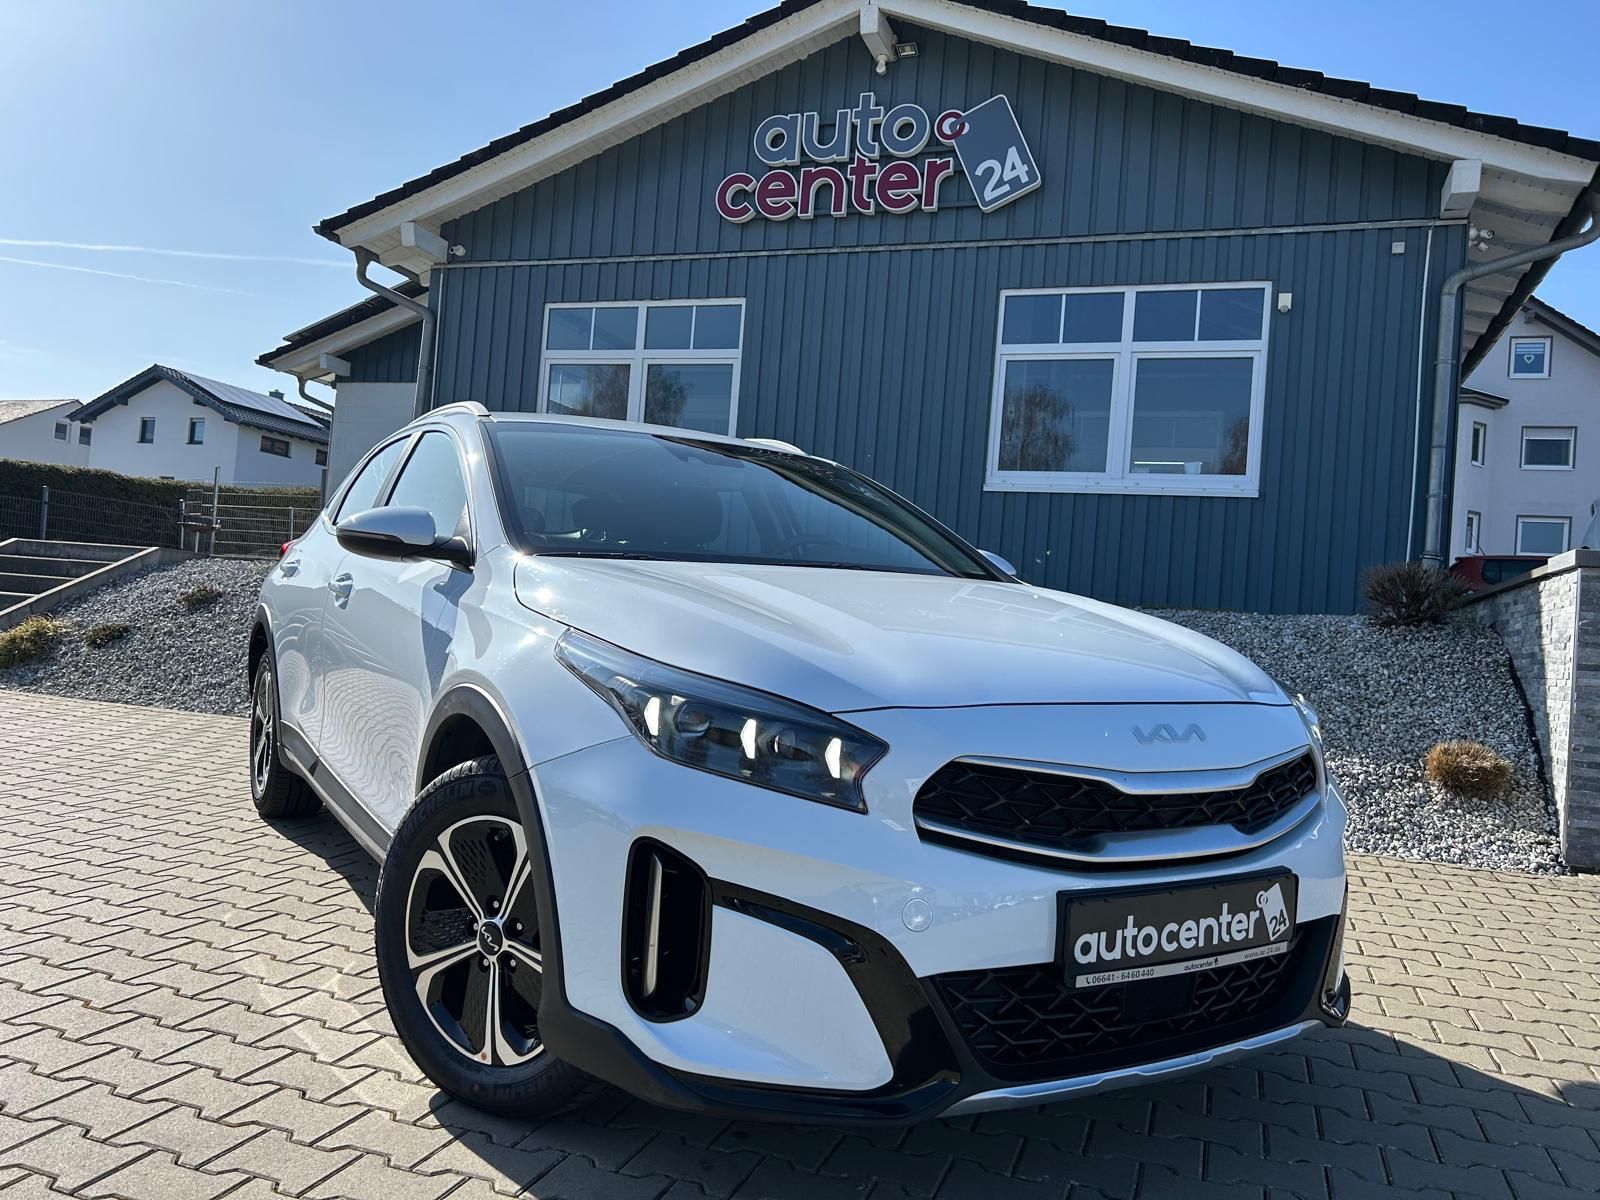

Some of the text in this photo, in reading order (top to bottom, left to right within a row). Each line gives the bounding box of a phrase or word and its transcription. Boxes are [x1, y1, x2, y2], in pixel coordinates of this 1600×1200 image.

[753, 92, 931, 167] auto
[715, 150, 954, 224] center
[974, 145, 1029, 202] 24
[1073, 902, 1260, 965] autocenter
[1268, 908, 1287, 936] 24
[1091, 973, 1116, 984] 06641
[1183, 960, 1213, 971] autocenter
